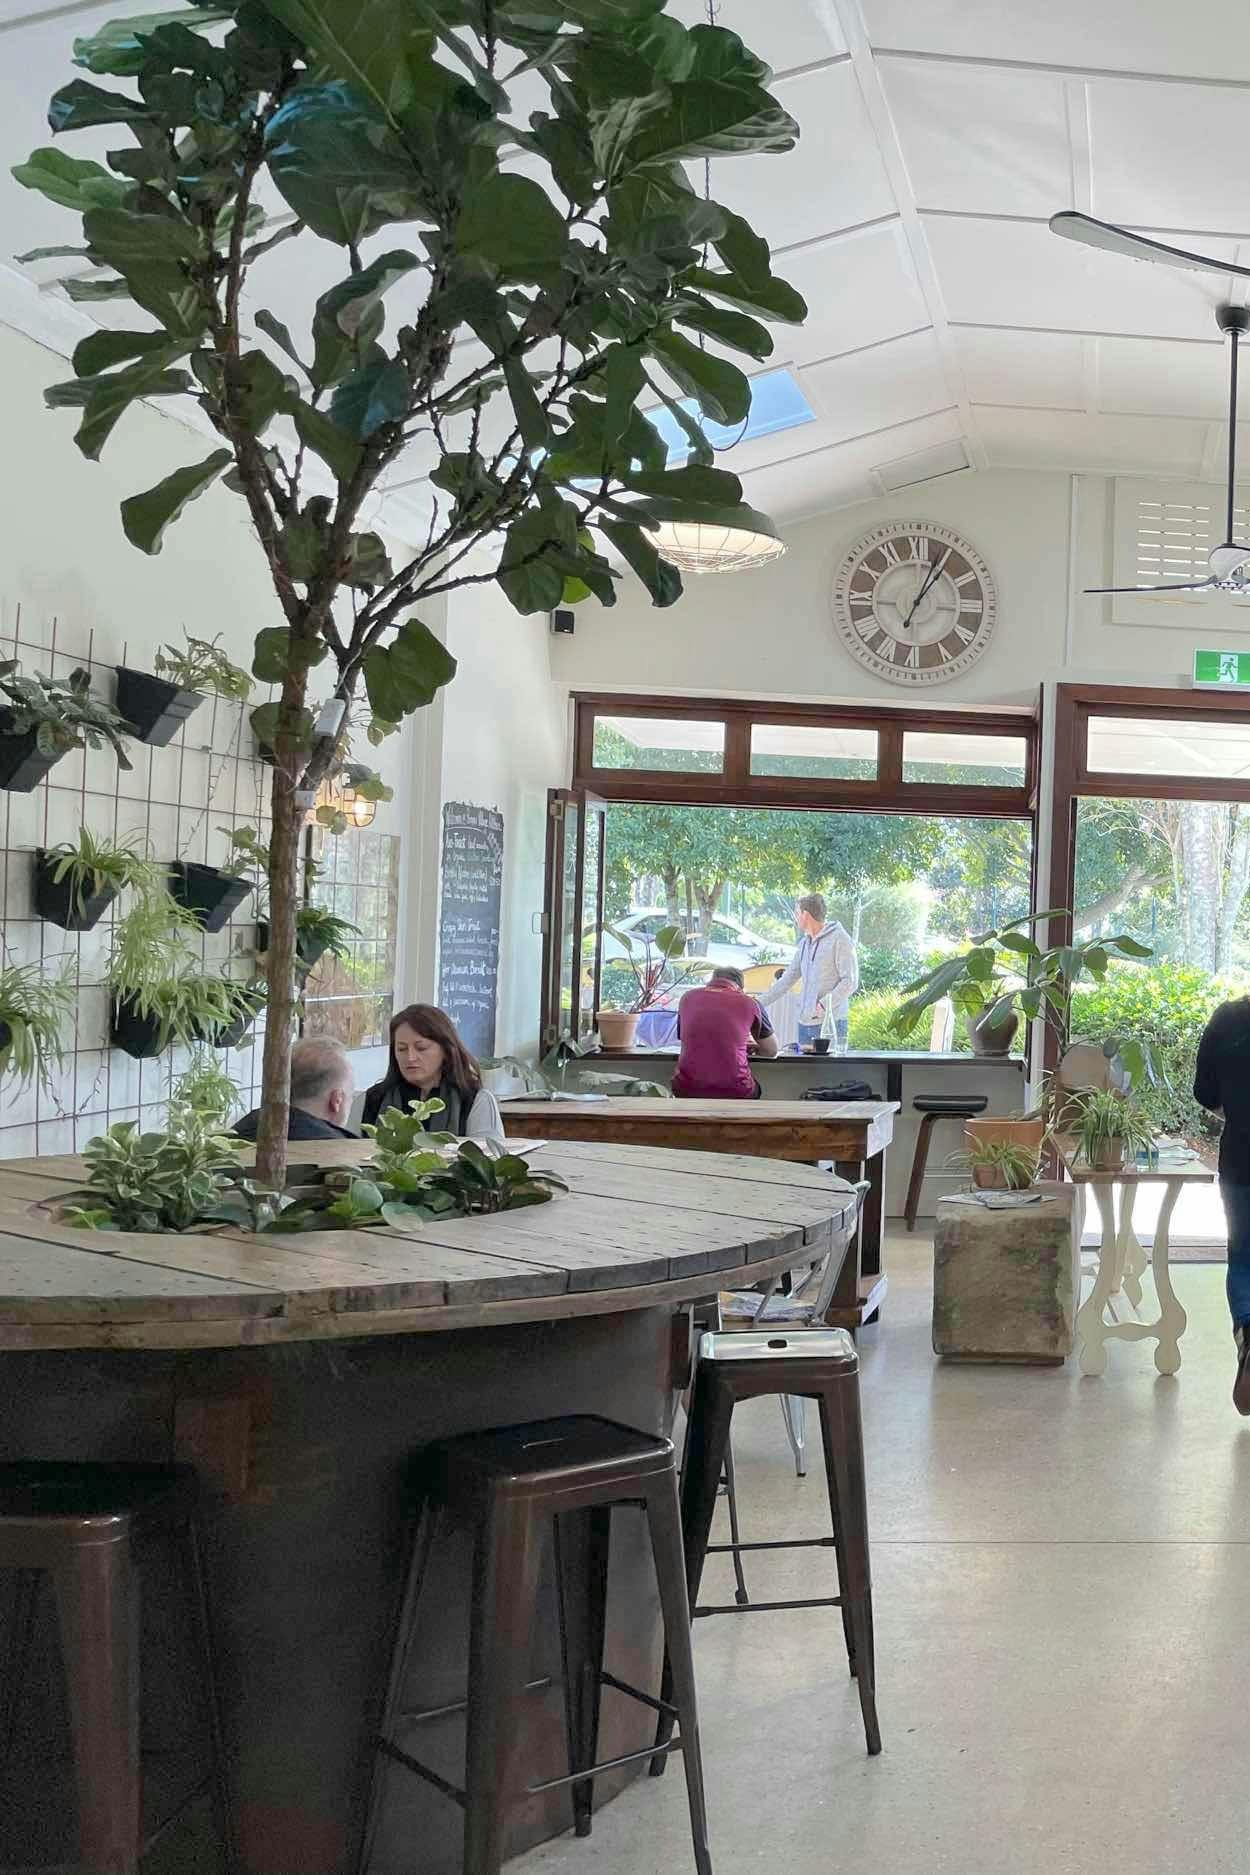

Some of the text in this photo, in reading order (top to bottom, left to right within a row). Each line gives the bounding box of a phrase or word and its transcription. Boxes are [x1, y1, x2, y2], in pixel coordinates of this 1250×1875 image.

[908, 536, 929, 561] XII
[960, 599, 983, 613] III
[937, 642, 953, 663] V
